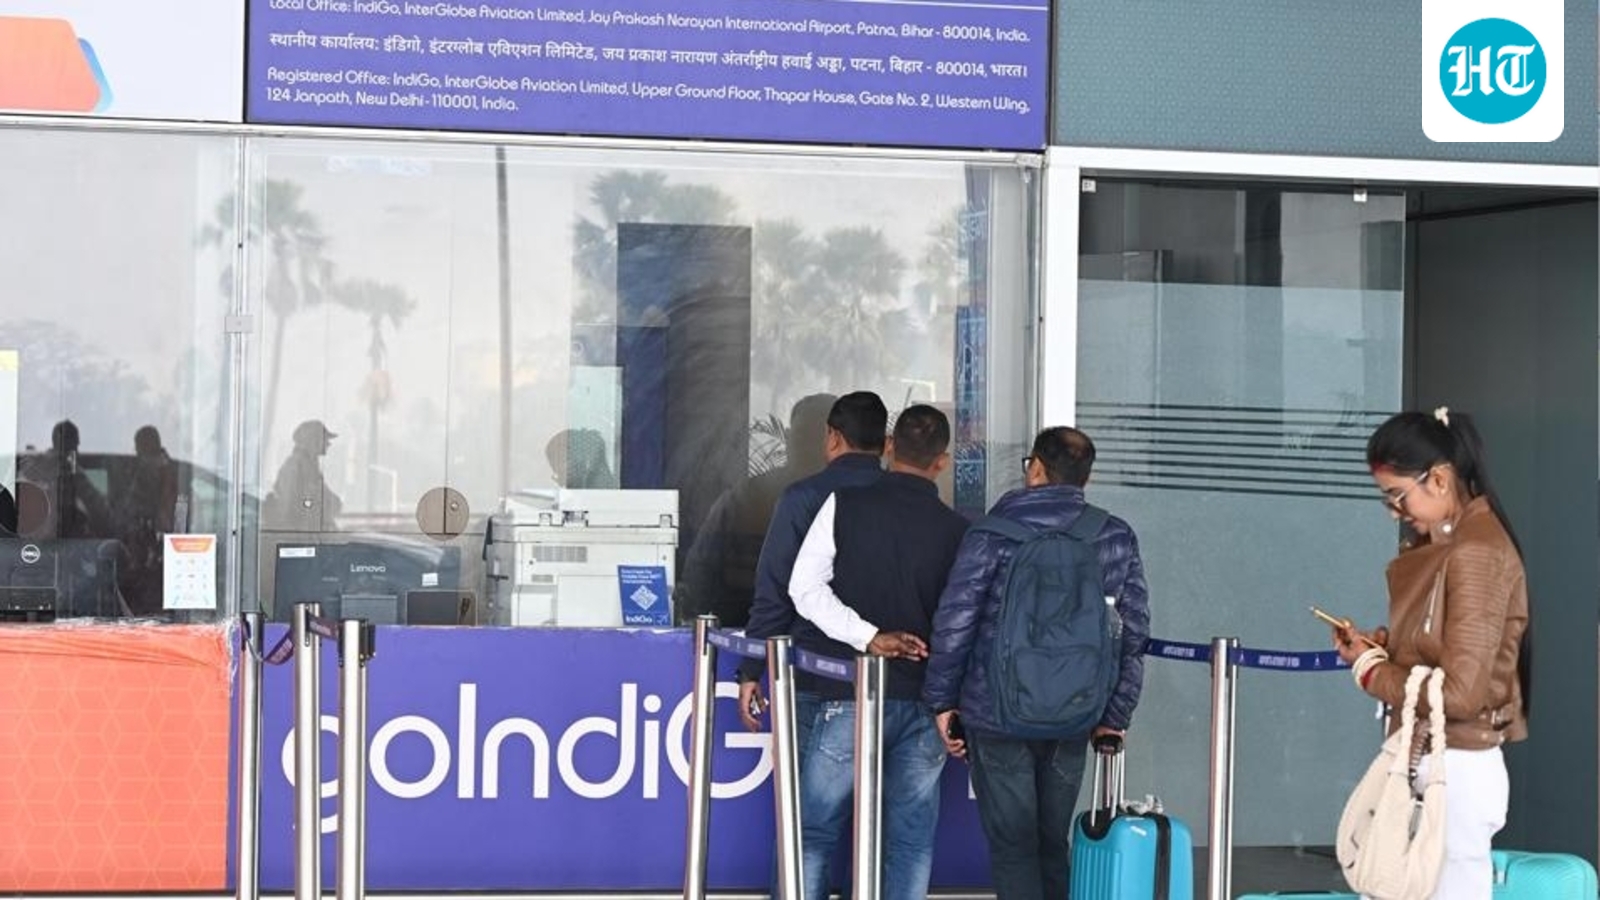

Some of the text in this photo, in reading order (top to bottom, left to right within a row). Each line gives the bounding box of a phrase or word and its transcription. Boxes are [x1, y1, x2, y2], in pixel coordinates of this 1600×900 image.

[270, 0, 303, 9] Local
[306, 0, 351, 12] Office:
[405, 2, 476, 17] InterGlobe
[480, 5, 533, 19] Aviation
[588, 10, 608, 25] Jay
[613, 11, 664, 25] Prakash
[668, 13, 722, 30] Narayan
[725, 17, 807, 32] International
[902, 23, 933, 37] Bihar
[997, 28, 1030, 41] India.
[270, 31, 316, 47] स्थानीय
[321, 33, 379, 50] कार्यालय:
[429, 38, 483, 54] इंटरग्लोब
[489, 39, 541, 58] एविएशन
[603, 48, 624, 60] जय
[629, 49, 666, 62] प्रकाश
[670, 51, 717, 64] नारायण
[782, 52, 812, 69] हवाई
[890, 56, 923, 73] बिहार
[991, 64, 1027, 78] भारत।
[267, 87, 290, 101] 124
[356, 91, 387, 105] New
[390, 92, 423, 106] Delhi
[482, 97, 518, 110] India.
[268, 67, 343, 84] Registered
[345, 70, 390, 84] Office:
[445, 75, 518, 90] InterGlobe
[521, 77, 576, 92] Aviation
[632, 82, 672, 98] Upper
[675, 84, 726, 98] Ground
[764, 87, 810, 104] Thapar
[860, 91, 894, 105] Gate
[897, 93, 918, 106] No.
[936, 94, 990, 109] Western
[350, 563, 386, 573] Lenovo
[282, 682, 775, 834] goIndiG
